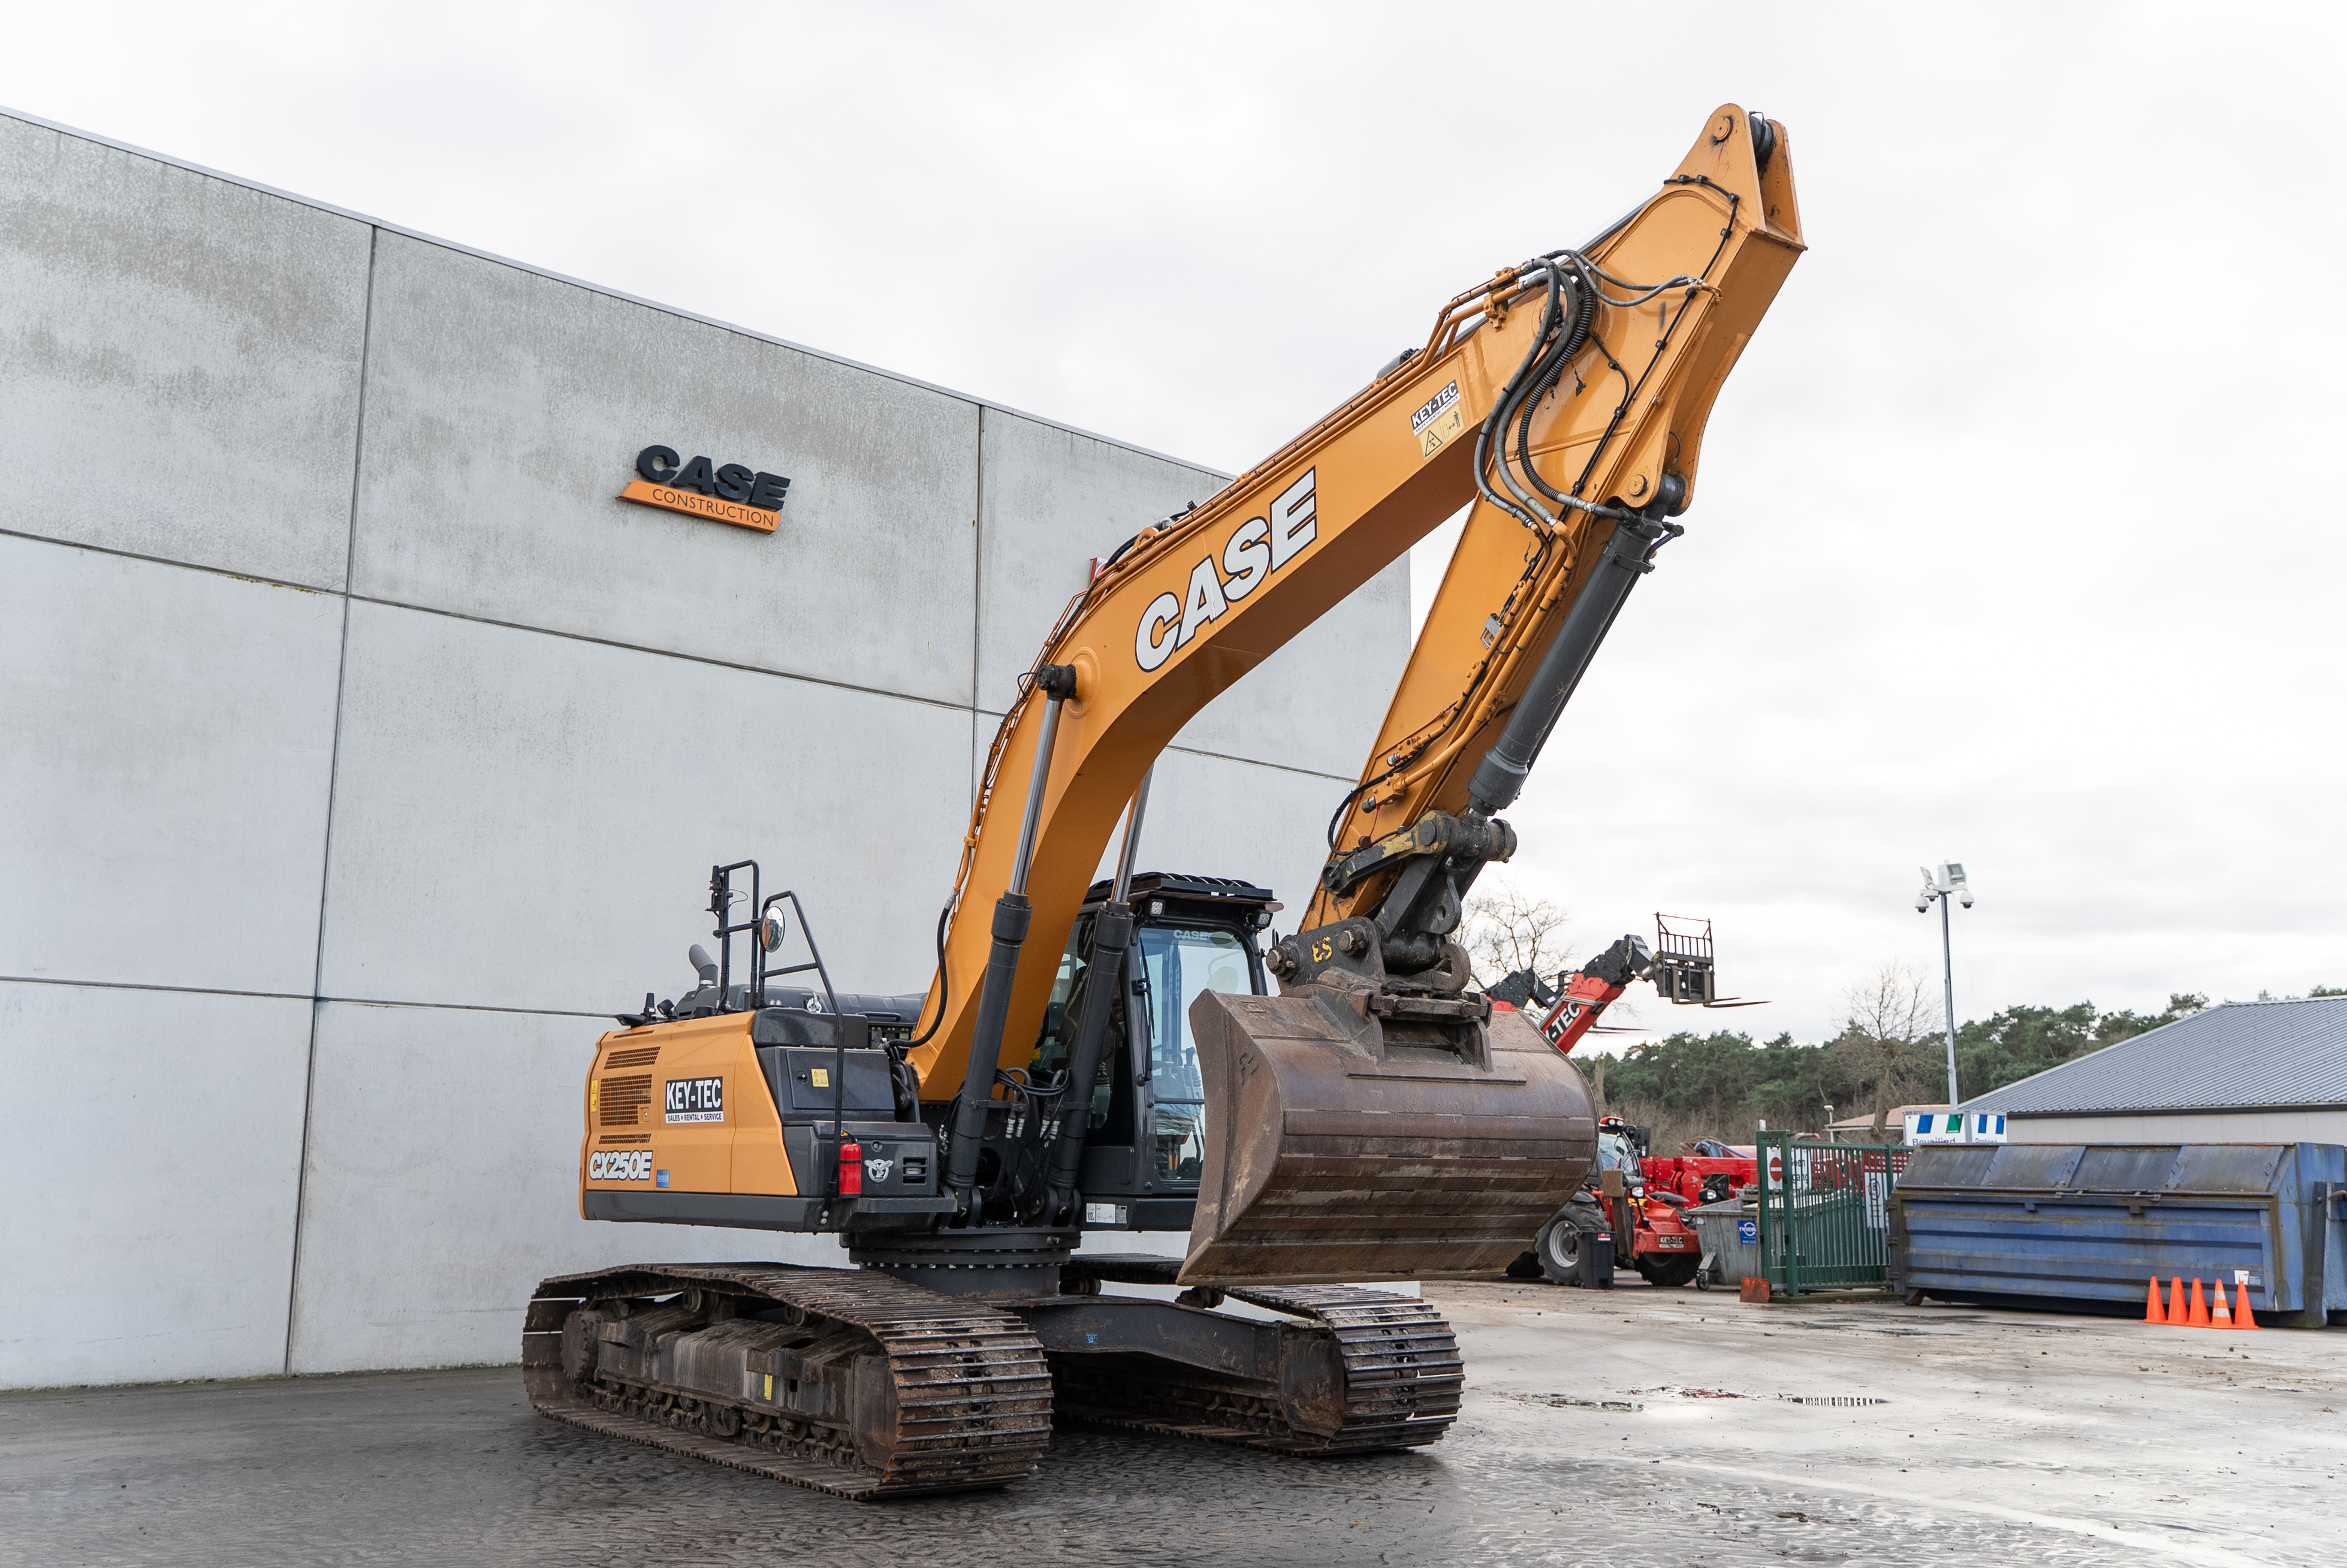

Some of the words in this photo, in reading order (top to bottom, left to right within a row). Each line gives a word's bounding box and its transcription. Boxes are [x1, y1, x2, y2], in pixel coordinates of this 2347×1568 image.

[1411, 382, 1457, 428] KEY-TEC
[636, 445, 791, 510] CASE
[653, 489, 774, 526] CONSTRUCTION
[1135, 465, 1317, 673] CASE
[1174, 930, 1208, 940] CASE
[666, 1079, 721, 1109] KEY-TEC
[589, 1150, 653, 1181] CX250E
